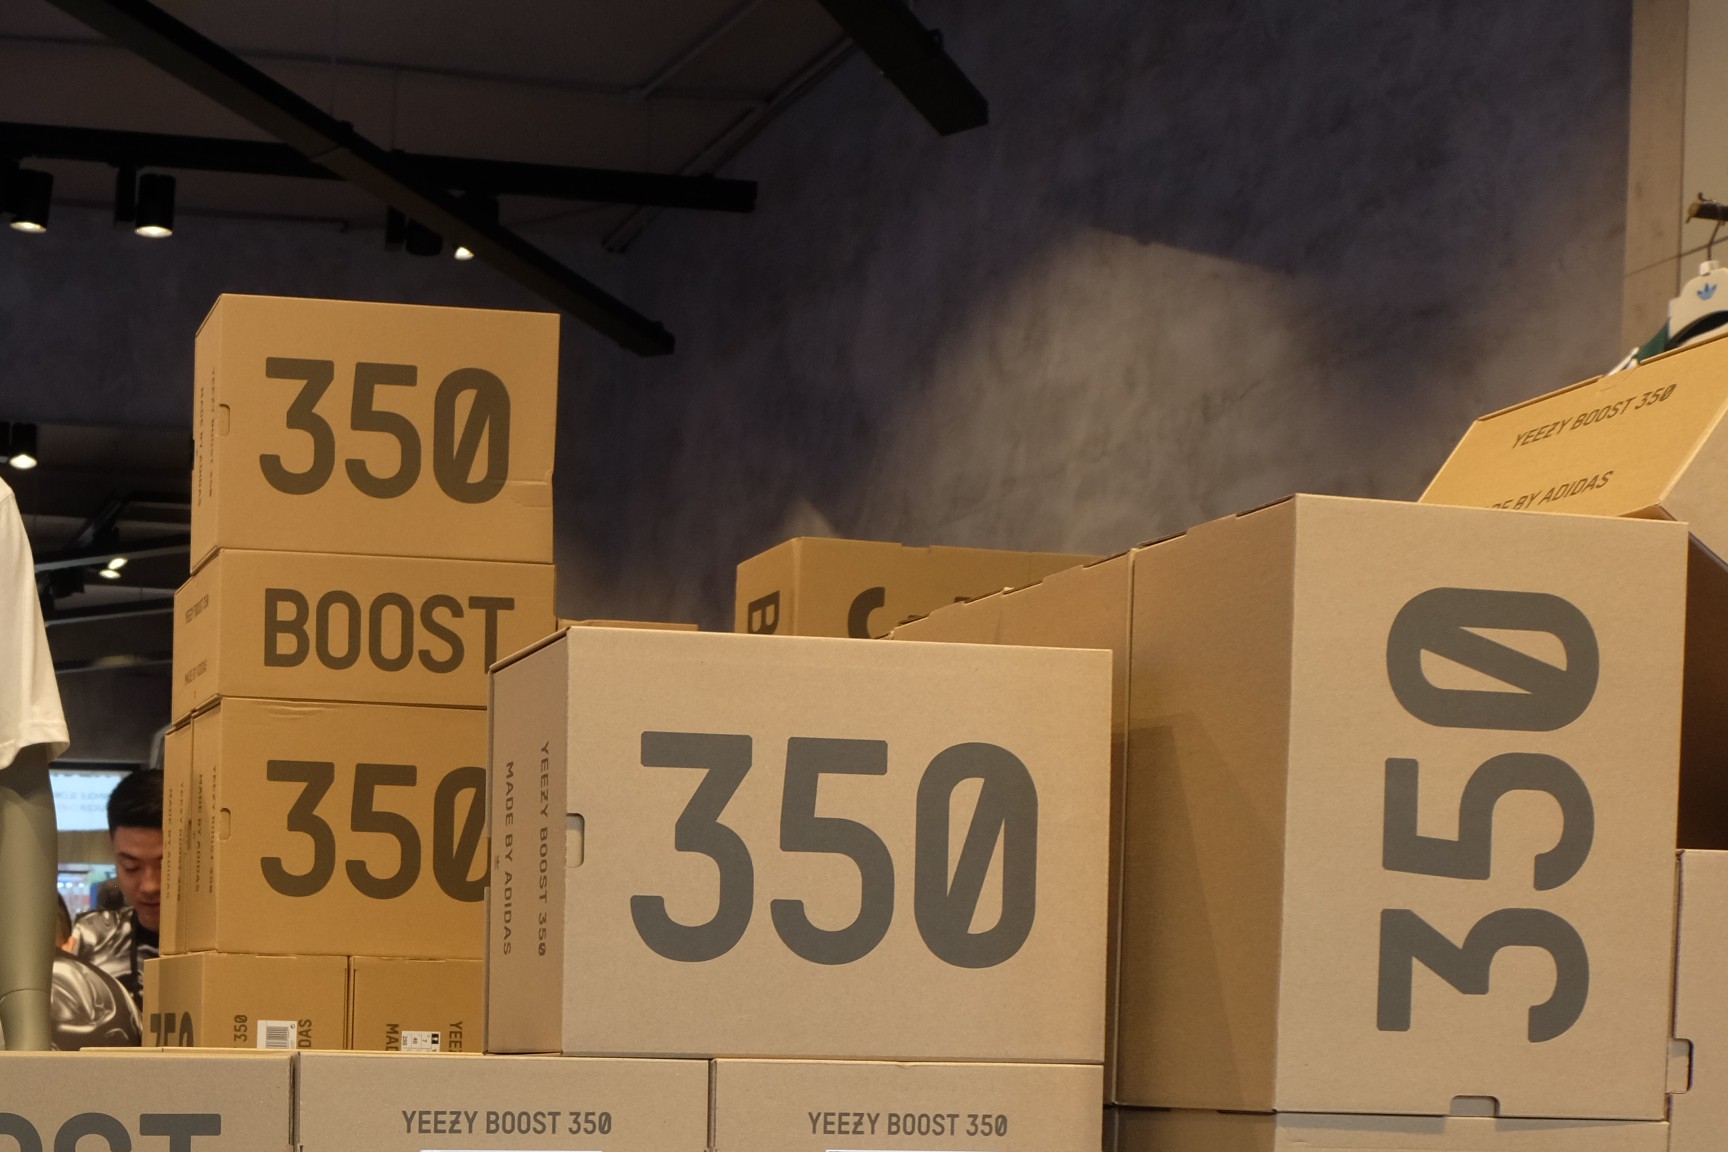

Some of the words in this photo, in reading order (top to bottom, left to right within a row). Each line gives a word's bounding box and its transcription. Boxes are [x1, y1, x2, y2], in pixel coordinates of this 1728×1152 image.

[259, 356, 511, 504] 350
[1512, 417, 1573, 449] YEEZY
[1570, 396, 1638, 431] BOOST
[1634, 383, 1678, 410] 350
[1537, 470, 1615, 505] ADIDAS
[263, 587, 515, 674] BOOST
[505, 761, 514, 827] MADE
[540, 741, 549, 818] YEEZY
[1376, 586, 1600, 1043] 350
[260, 760, 490, 903] 350
[504, 834, 513, 862] BY
[539, 826, 548, 903] BOOST
[630, 730, 1039, 969] 350
[503, 871, 512, 955] ADIDAS
[538, 911, 547, 956] 350
[234, 1015, 248, 1041] 350
[402, 1111, 478, 1133] YEEZY
[486, 1111, 561, 1134] BOOST
[569, 1112, 611, 1134] 350
[809, 1112, 880, 1134] YEEZY
[888, 1113, 959, 1136] BOOST
[967, 1114, 1007, 1136] 350
